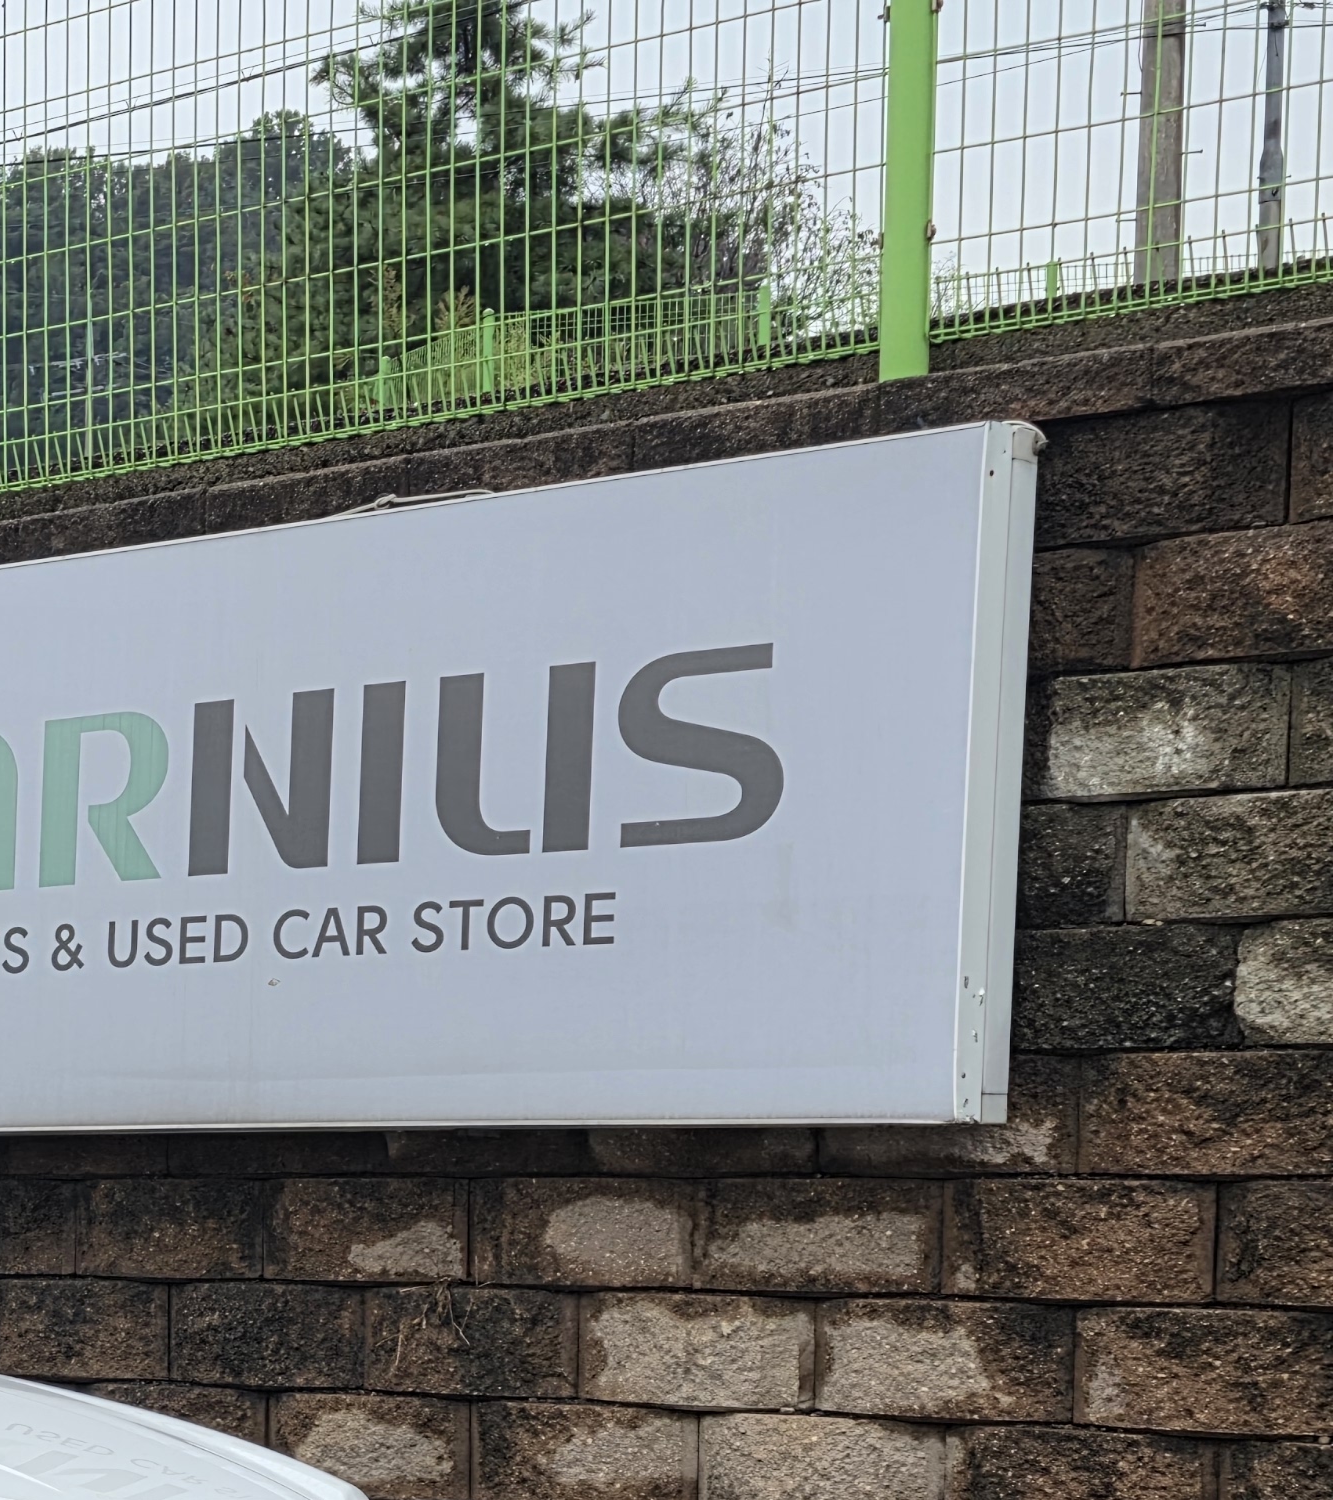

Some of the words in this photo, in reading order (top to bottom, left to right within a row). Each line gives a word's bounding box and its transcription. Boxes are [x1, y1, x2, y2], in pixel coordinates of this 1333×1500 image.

[51, 923, 85, 972] &
[107, 913, 249, 969] USED
[273, 905, 388, 960] CAR
[411, 891, 617, 953] STORE
